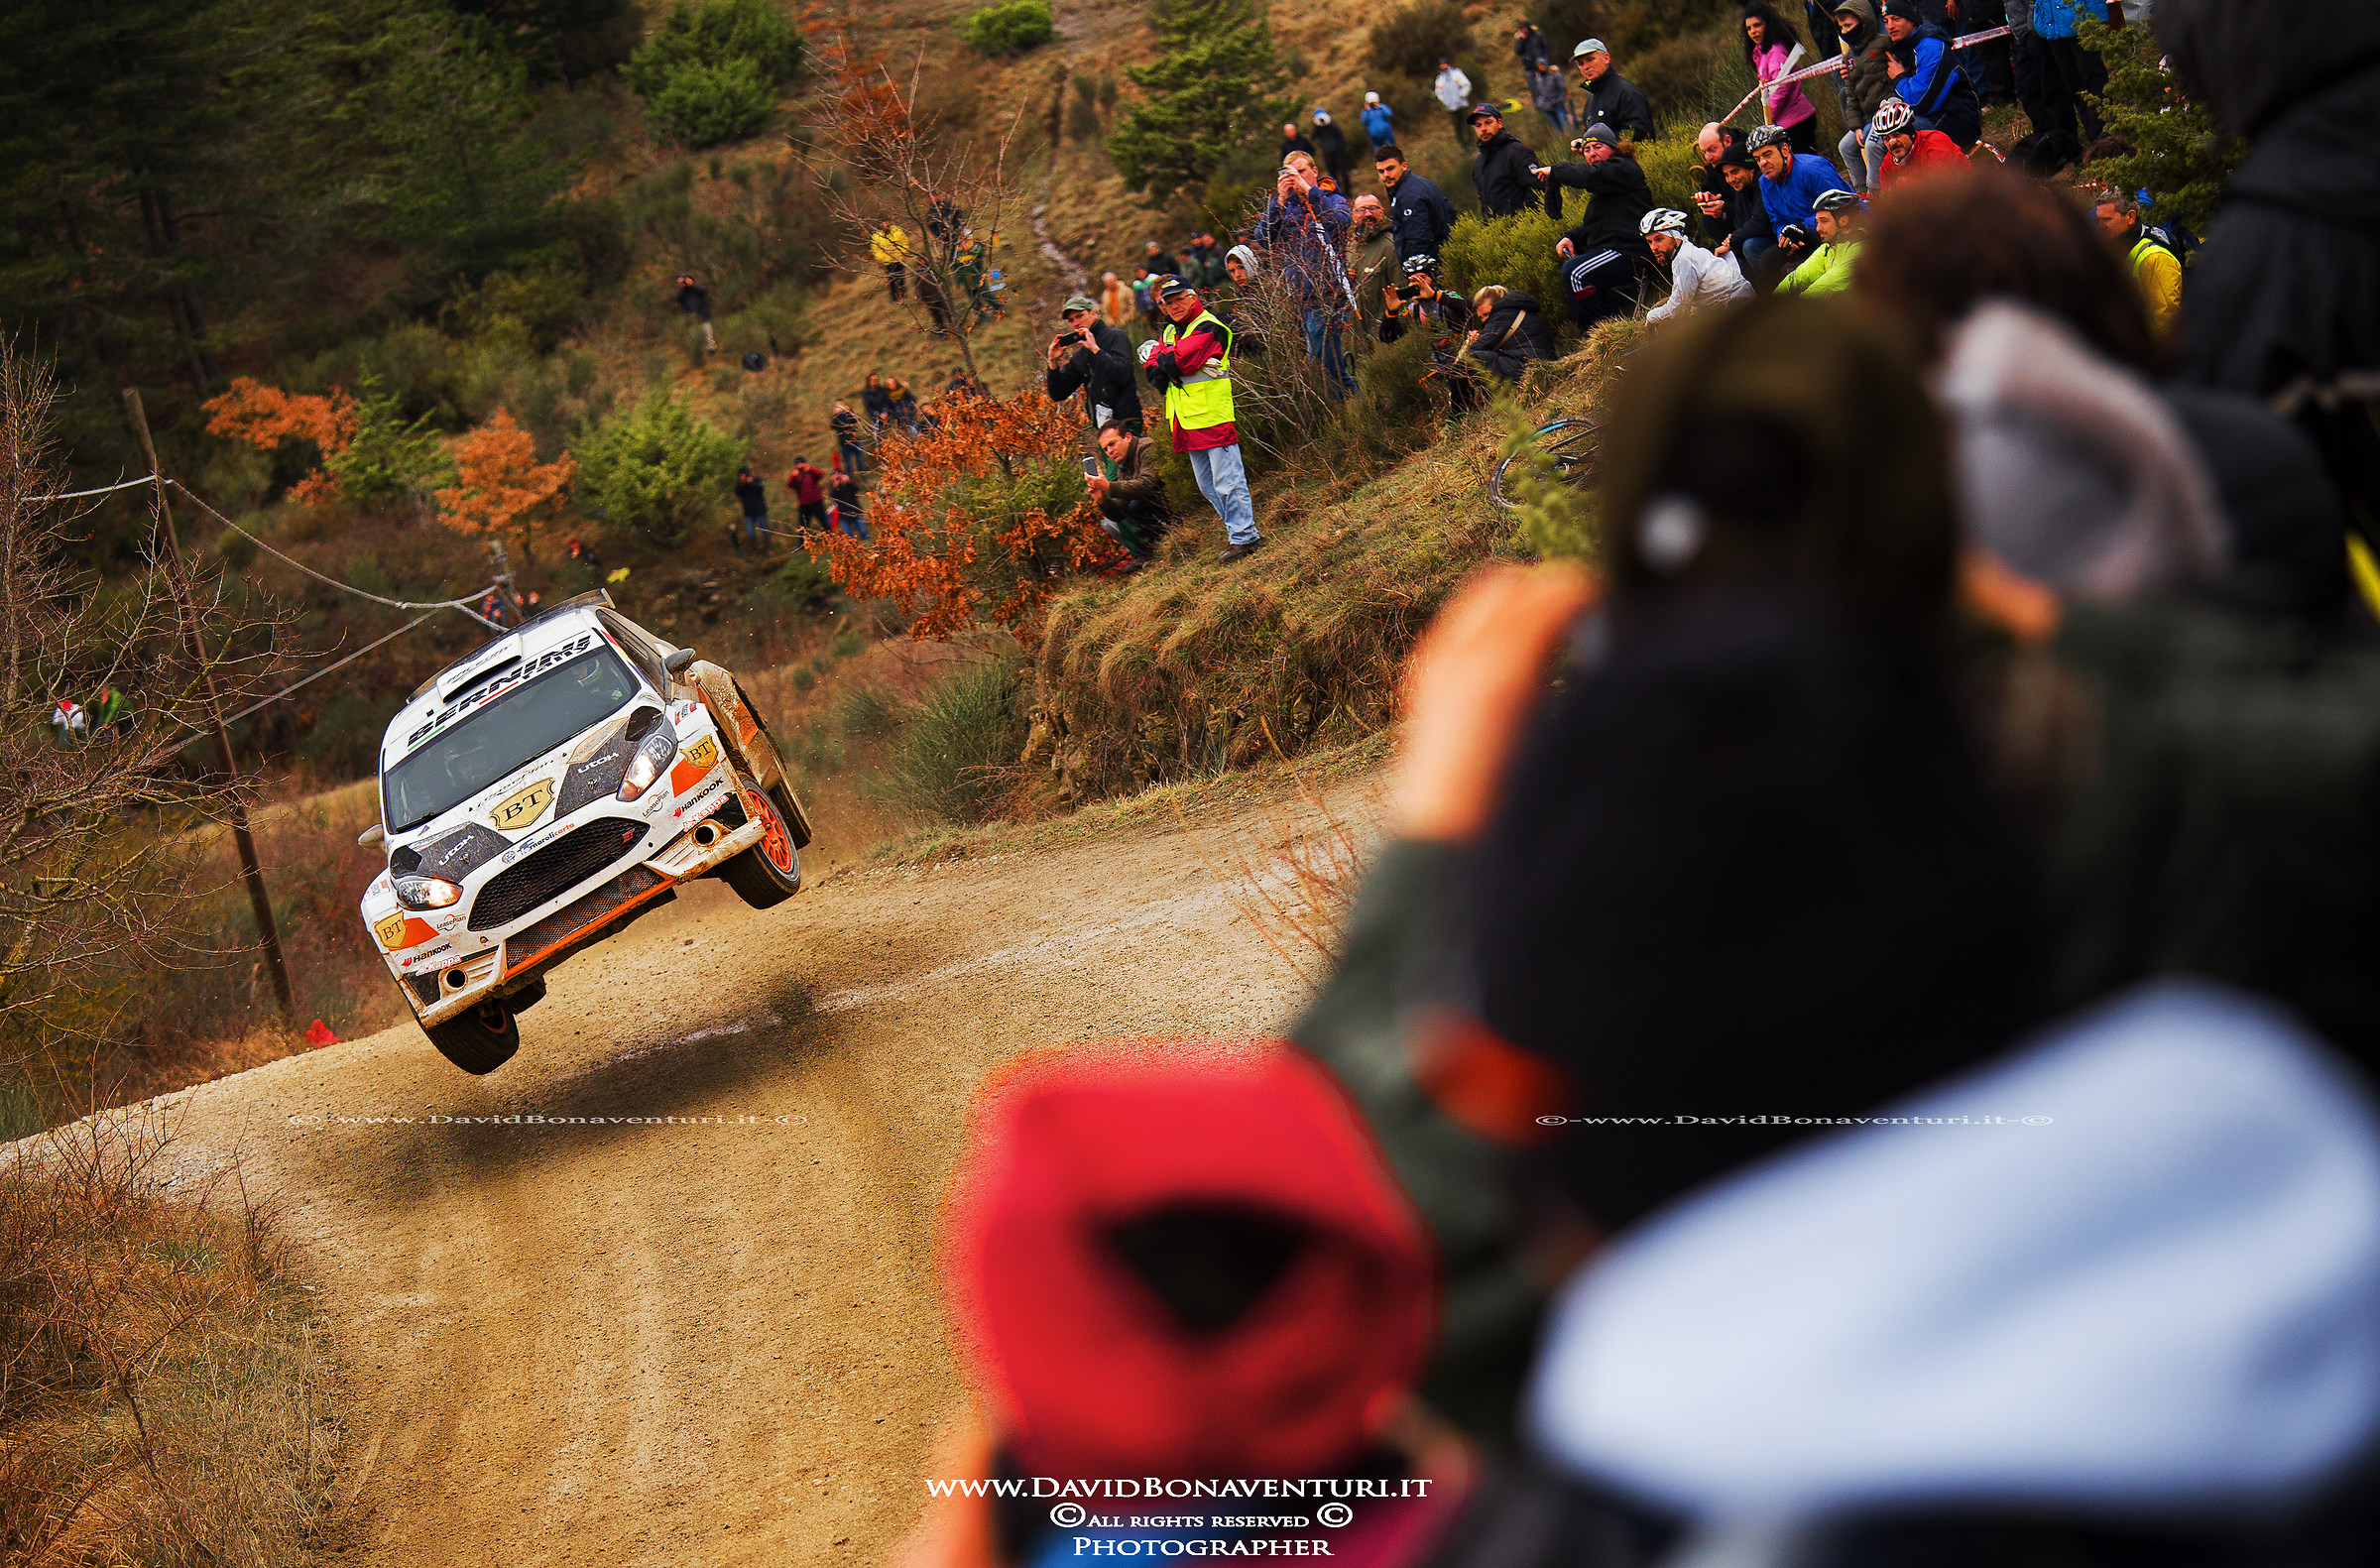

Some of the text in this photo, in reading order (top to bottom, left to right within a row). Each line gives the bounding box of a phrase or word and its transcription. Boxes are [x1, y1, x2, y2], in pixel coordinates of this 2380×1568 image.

[689, 740, 711, 762] BT
[502, 788, 543, 823] BT
[622, 828, 636, 843] ST
[382, 919, 402, 941] BT
